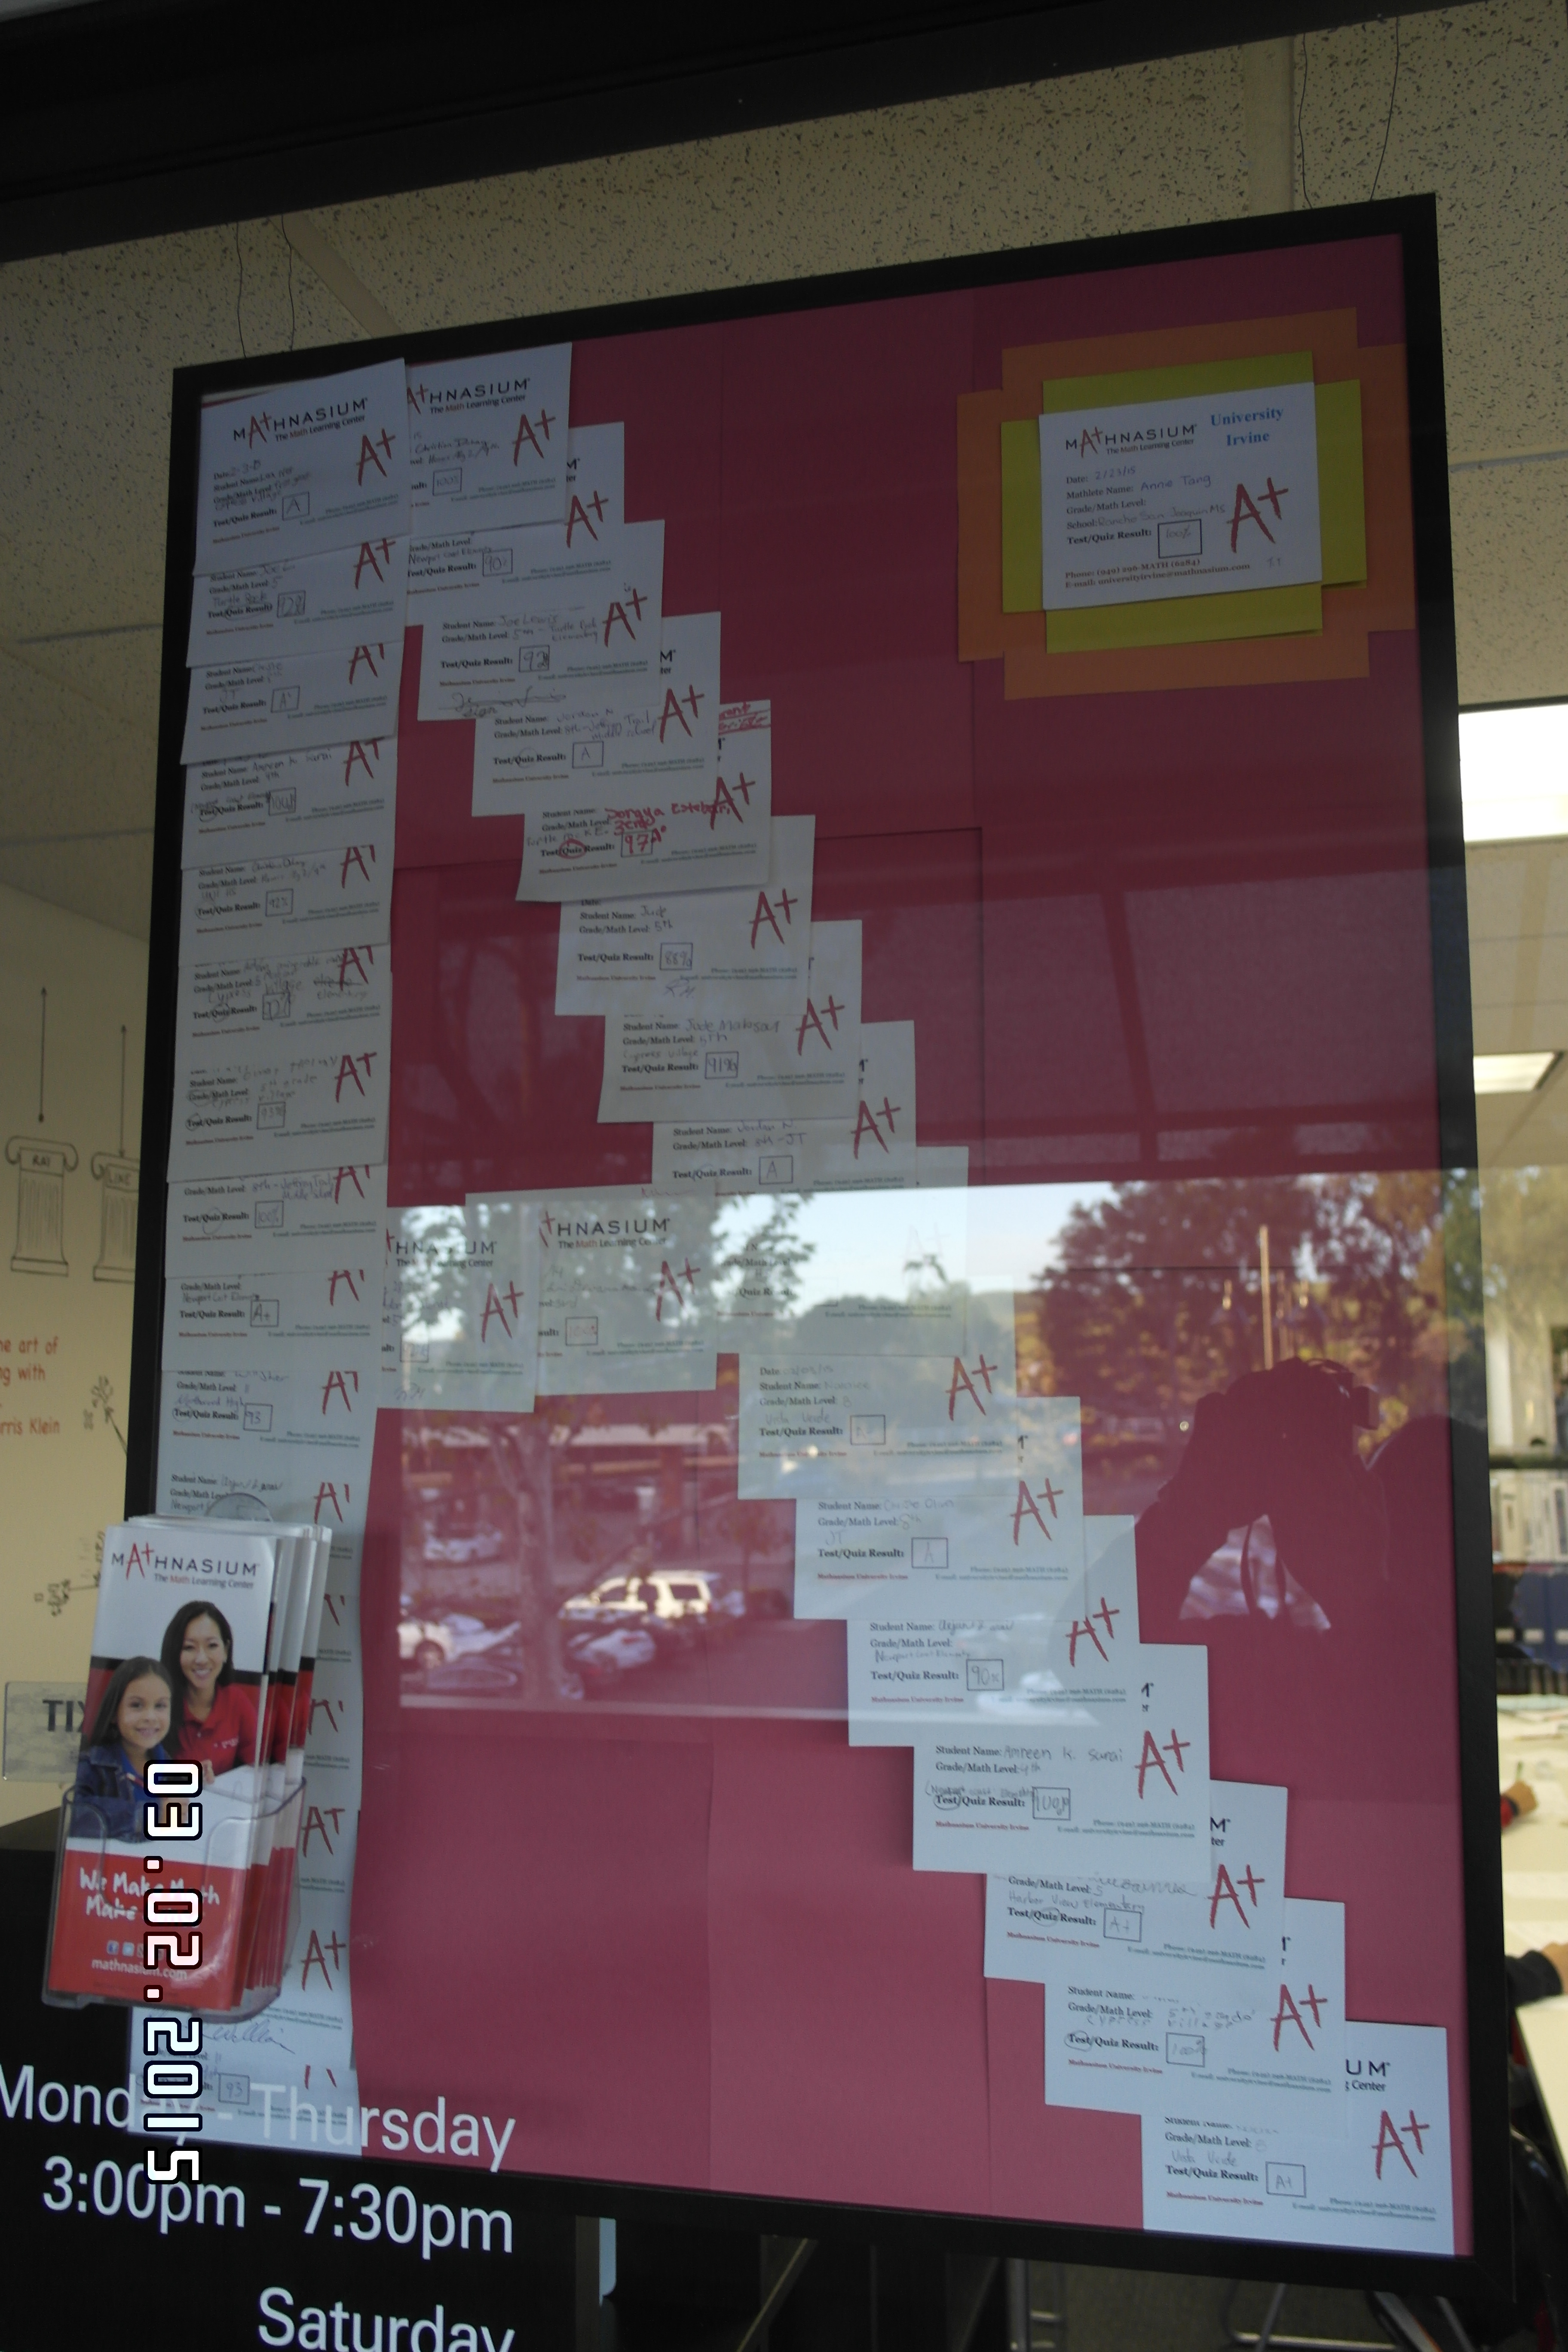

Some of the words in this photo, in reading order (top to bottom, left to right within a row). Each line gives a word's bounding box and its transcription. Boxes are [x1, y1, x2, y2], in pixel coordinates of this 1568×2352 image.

[430, 405, 444, 414] The
[466, 399, 499, 408] Learning
[501, 394, 526, 403] Center
[1211, 408, 1283, 426] University
[275, 433, 288, 442] The
[309, 422, 341, 435] Learning
[342, 414, 365, 426] Center
[512, 408, 556, 467] A+
[1106, 447, 1119, 455] The
[1120, 444, 1138, 453] Math
[1139, 441, 1170, 452] Learning
[1172, 437, 1194, 447] Center
[1227, 432, 1270, 447] Irvine
[355, 428, 396, 487] A+
[1066, 475, 1089, 484] Date:
[1066, 488, 1104, 500] Mathlete
[1106, 485, 1133, 495] Name:
[1141, 480, 1173, 491] Annie
[1180, 474, 1211, 488] Tang
[1066, 502, 1119, 515] Grade/Math
[1121, 499, 1146, 509] Level:
[1225, 477, 1289, 553] A+
[564, 490, 608, 548] A+
[1066, 520, 1098, 530] School:
[1066, 531, 1115, 545] Test/Quiz
[1117, 528, 1152, 539] Result:
[353, 538, 396, 590] A+
[1065, 570, 1094, 578] Phone:
[442, 620, 471, 630] Student
[473, 619, 496, 629] Name:
[602, 588, 648, 647] A+
[495, 716, 524, 726] Student
[525, 714, 548, 723] Name:
[658, 684, 705, 744] A+
[710, 772, 756, 830] A+
[580, 912, 610, 921] Student
[612, 911, 637, 919] Name:
[749, 888, 798, 949] A+
[579, 925, 625, 934] Grade/Math
[627, 924, 651, 933] Level:
[623, 1022, 653, 1031] Student
[655, 1022, 680, 1030] Name:
[795, 995, 845, 1057] A+
[623, 1036, 669, 1046] Grade/Math
[849, 1096, 901, 1160] A+
[655, 1258, 700, 1322] A+
[479, 1280, 524, 1343] A+
[18, 1337, 38, 1354] art
[46, 1336, 58, 1354] of
[18, 1363, 45, 1381] with
[945, 1354, 998, 1421] A+
[760, 1397, 812, 1407] Grade/Math
[30, 1417, 59, 1434] Klein
[760, 1427, 807, 1436] Test/Quiz
[809, 1427, 843, 1436] Result:
[818, 1502, 851, 1511] Student
[853, 1502, 882, 1510] Name:
[1008, 1477, 1064, 1546] A+
[818, 1517, 870, 1527] Grade/Math
[873, 1518, 898, 1526] Level:
[111, 1541, 260, 1580] MATHNASIUM
[818, 1549, 866, 1559] Test/Quiz
[869, 1549, 904, 1558] Result:
[154, 1573, 168, 1583] The
[169, 1574, 190, 1584] Math
[192, 1577, 227, 1588] Learning
[228, 1578, 254, 1590] Center
[1065, 1596, 1120, 1668] A+
[870, 1638, 925, 1648] Grade/Math
[928, 1639, 953, 1648] Level:
[870, 1671, 920, 1681] Test/Quiz
[923, 1671, 959, 1680] Result:
[1134, 1728, 1191, 1800] A+
[935, 1795, 986, 1807] Test/Quiz
[989, 1797, 1026, 1807] Result:
[80, 1867, 107, 1890] We
[1204, 1864, 1265, 1930] A+
[86, 1894, 138, 1921] Make
[1008, 1907, 1059, 1922] Test/Quiz
[1060, 1913, 1096, 1926] Result:
[92, 1957, 187, 1979] mathnasium.com
[301, 1929, 346, 1991] A+
[1268, 1983, 1327, 2052] A+
[1068, 2034, 1118, 2047] Test/Quiz
[1121, 2040, 1159, 2052] Result:
[1352, 2080, 1387, 2092] Center
[251, 2081, 516, 2173] Thursday
[1372, 2109, 1430, 2180] A+
[1165, 2164, 1218, 2178] Test/Quiz
[1220, 2169, 1259, 2182] Result:
[43, 2155, 245, 2234] 3:00pm
[299, 2178, 513, 2260] 7:30pm
[258, 2286, 516, 2352] Saturday
